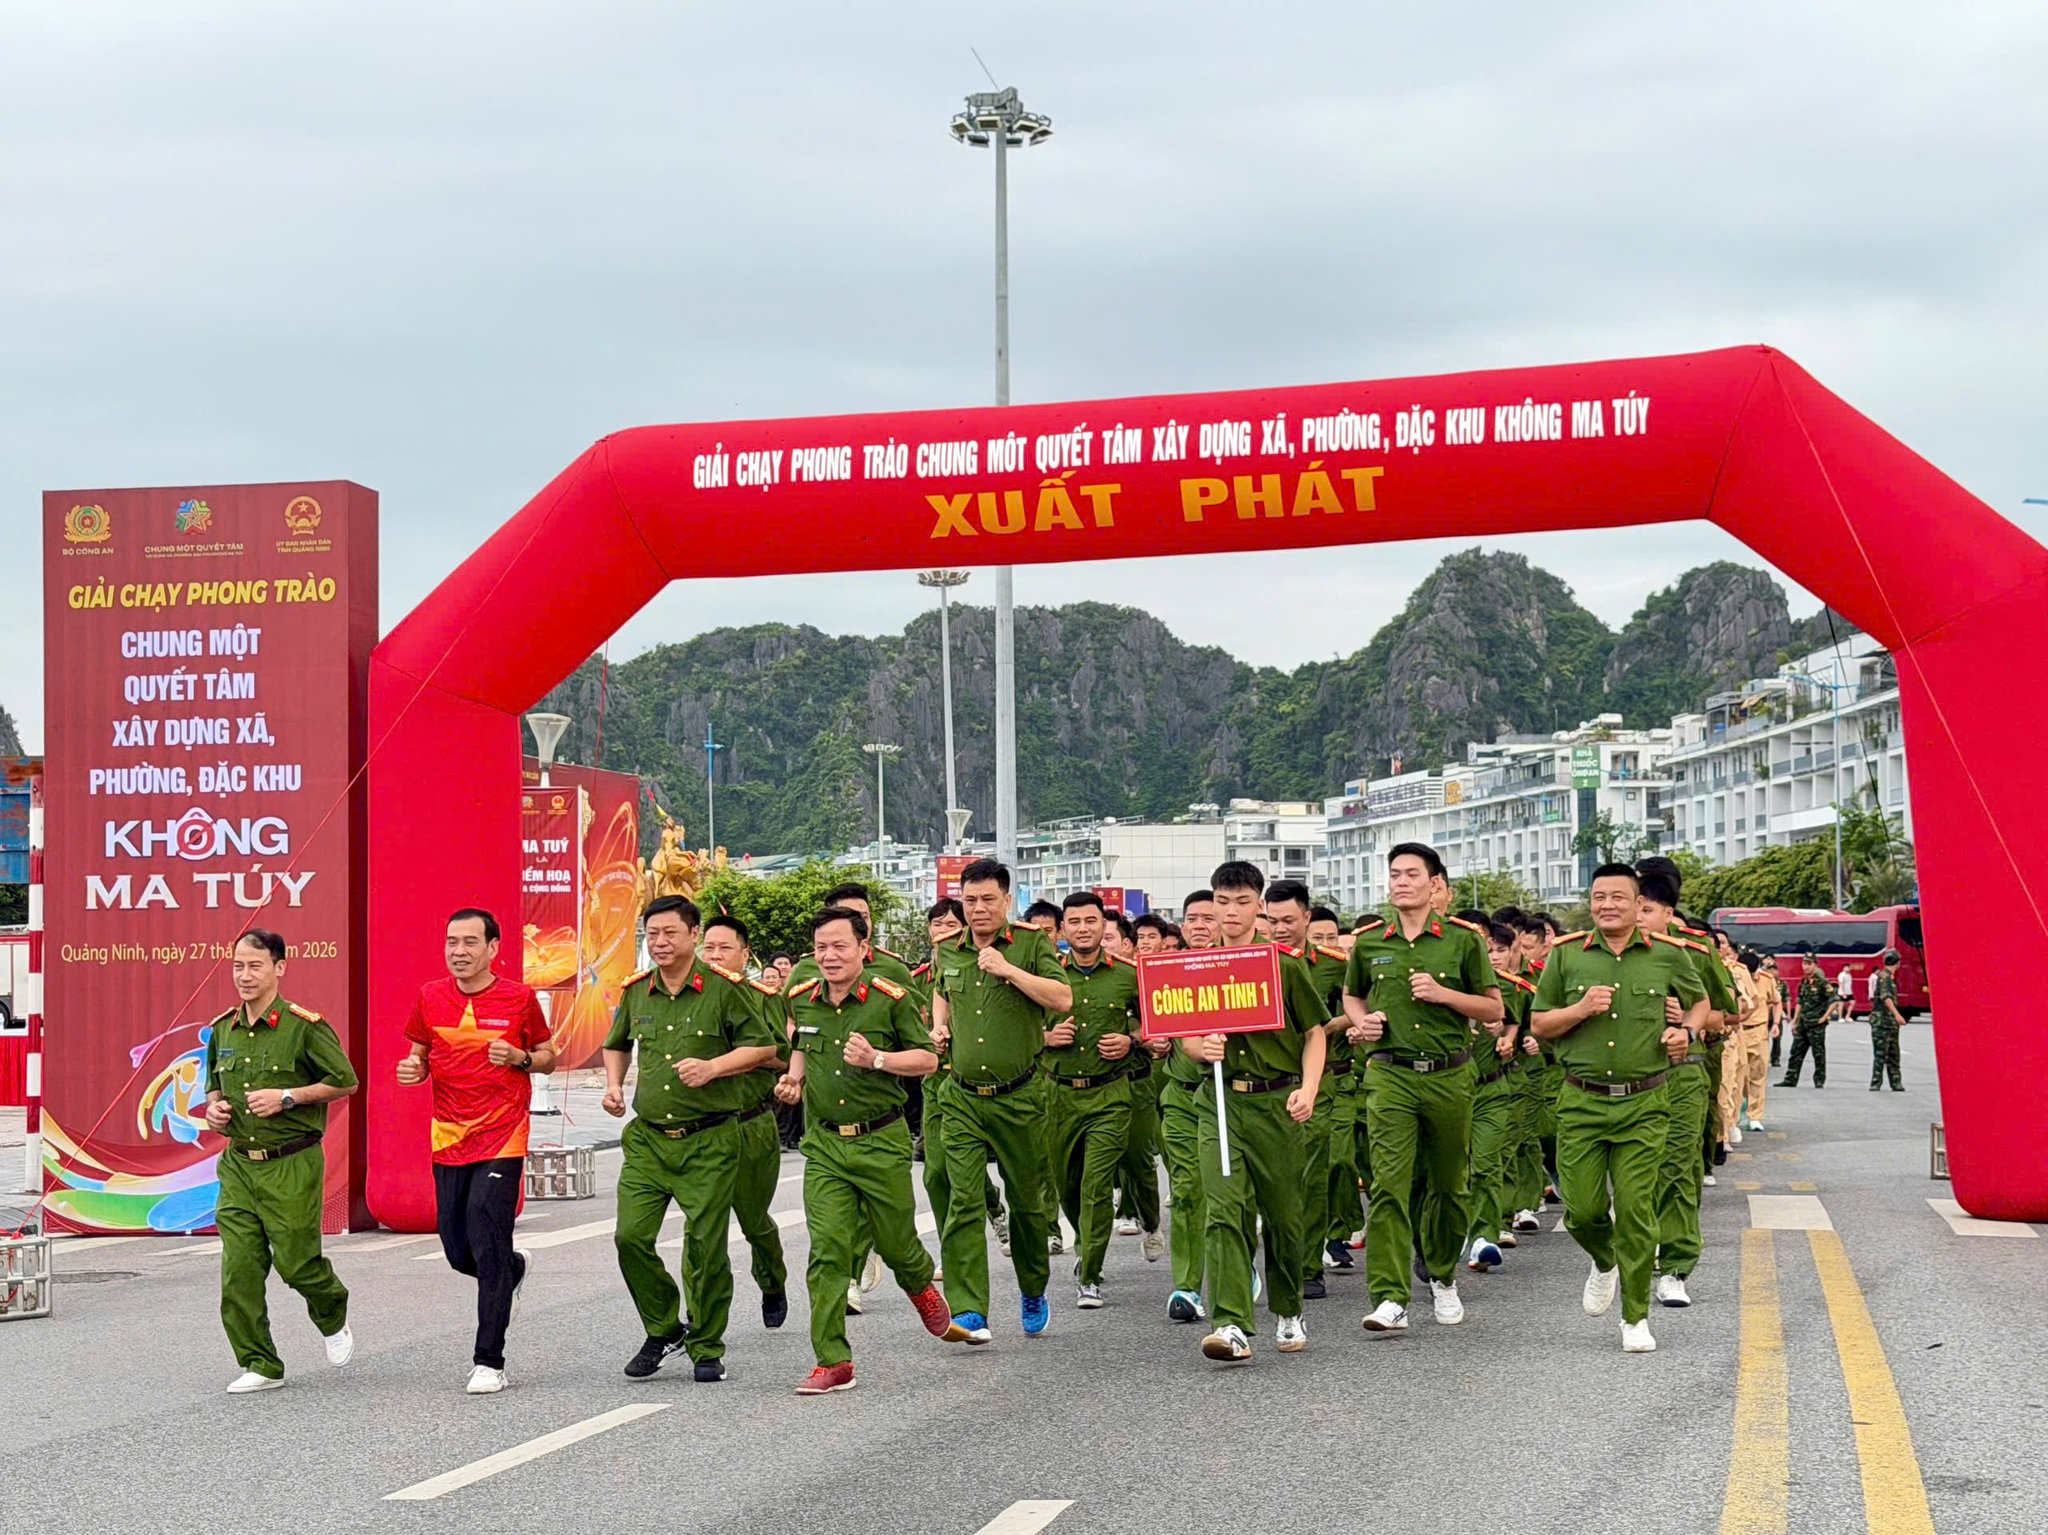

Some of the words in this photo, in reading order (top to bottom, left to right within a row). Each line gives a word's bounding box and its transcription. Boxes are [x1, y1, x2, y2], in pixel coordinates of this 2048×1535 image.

[693, 442, 729, 489] GIẢI
[736, 449, 783, 492] CHẠY
[791, 446, 852, 482] PHONG
[863, 436, 908, 480] TRÀO
[916, 440, 978, 478] CHUNG
[1035, 422, 1094, 474] QUYẾT
[1102, 422, 1143, 465] TÂM
[1152, 418, 1190, 462] XÂY
[1199, 419, 1252, 466] DỰNG
[1260, 412, 1295, 459] XÃ,
[1302, 407, 1390, 454] PHƯỜNG,
[1395, 404, 1436, 455] ĐẶC
[1445, 407, 1486, 445] KHU
[1494, 397, 1562, 443] KHÔNG
[1571, 400, 1605, 439] MA
[1612, 390, 1650, 436] TÚY
[924, 470, 1122, 539] XUẤT
[1180, 459, 1385, 523] PHÁT
[144, 545, 175, 553] CHUNG
[176, 543, 195, 552] MỘT
[68, 576, 115, 609] GIẢI
[120, 582, 183, 613] CHẠY
[186, 580, 268, 605] PHONG
[274, 572, 336, 603] TRÀO
[121, 629, 203, 659] CHUNG
[209, 623, 262, 661] MỘT
[124, 665, 198, 705] QUYẾT
[203, 667, 256, 700] TÂM
[112, 714, 159, 747] XÂY
[164, 716, 230, 751] DỰNG
[236, 712, 275, 747] XÃ,
[89, 761, 193, 796] PHƯỜNG,
[198, 761, 247, 798] ĐẶC
[253, 764, 302, 792] KHU
[104, 807, 289, 861] KHÔNG
[542, 836, 569, 853] TUÝ
[85, 873, 180, 910] MA
[193, 863, 317, 909] TÚY
[61, 943, 108, 965] Quảng
[111, 942, 149, 963] Ninh,
[152, 943, 187, 965] ngày
[189, 943, 206, 959] 27
[210, 941, 233, 959] thá
[302, 941, 338, 958] 2026
[1152, 983, 1194, 1016] CÔNG
[1198, 984, 1220, 1012] AN
[1221, 974, 1258, 1010] TỈNH
[1260, 981, 1270, 1006] 1
